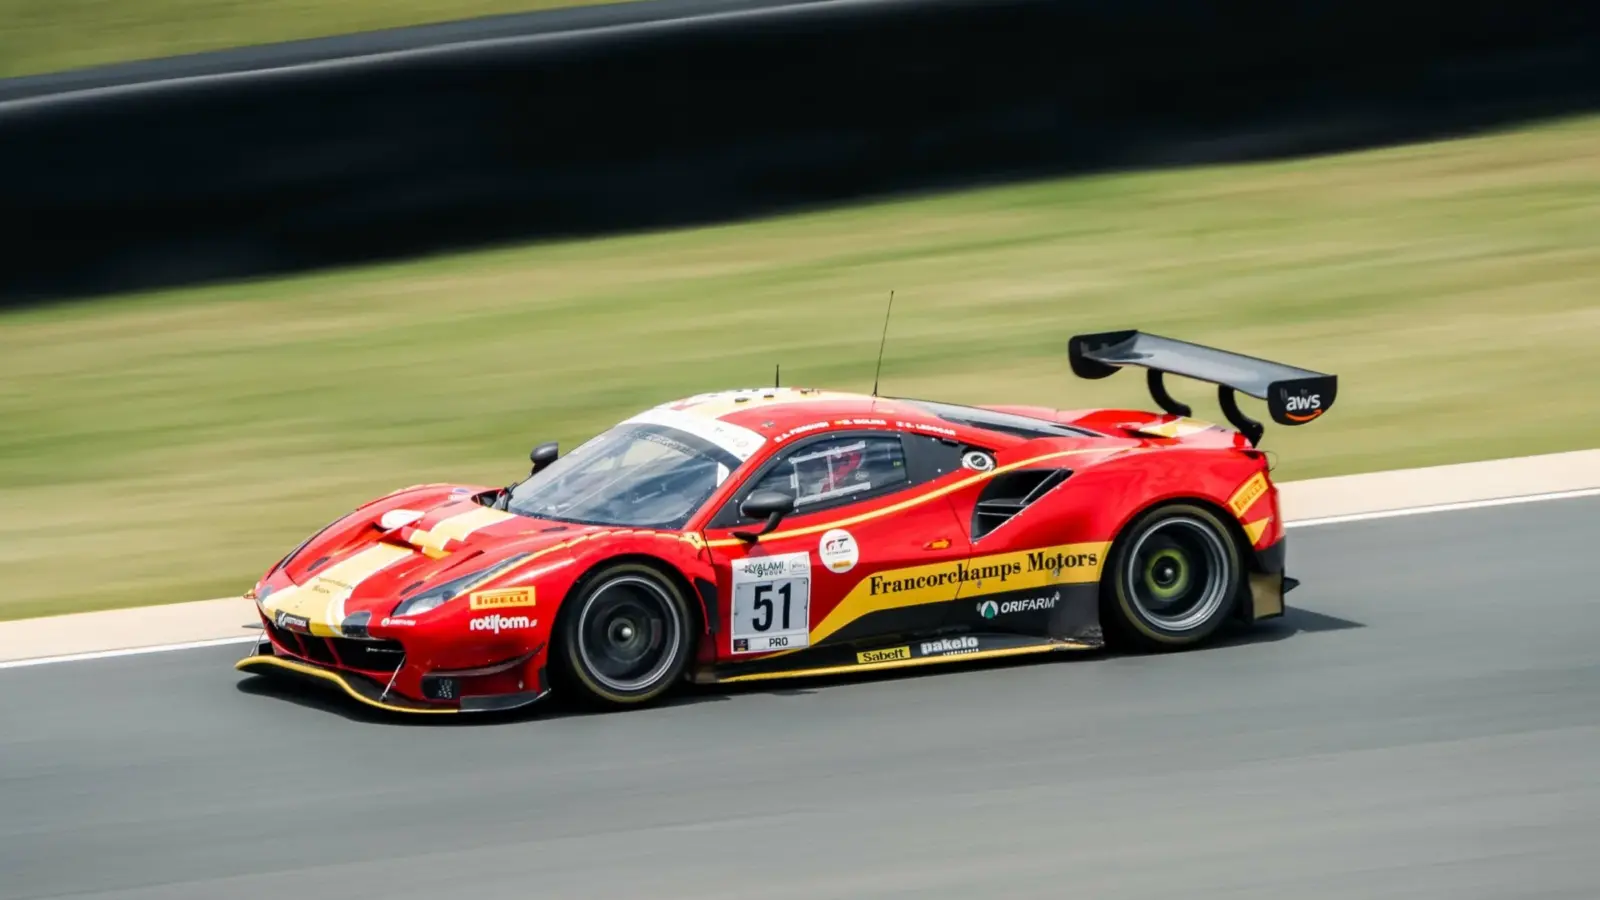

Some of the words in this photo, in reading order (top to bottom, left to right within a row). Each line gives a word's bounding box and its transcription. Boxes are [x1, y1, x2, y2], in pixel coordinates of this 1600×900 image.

[1286, 394, 1321, 411] aws
[869, 563, 1021, 596] Francorchamps
[1027, 551, 1098, 573] Motors
[476, 590, 529, 606] PIRELLI
[1000, 597, 1055, 614] ORIFARM
[752, 582, 791, 632] 51
[470, 613, 530, 635] rotiform
[769, 637, 789, 647] PRO
[920, 636, 979, 655] pakelo
[863, 648, 905, 662] Sabelt
